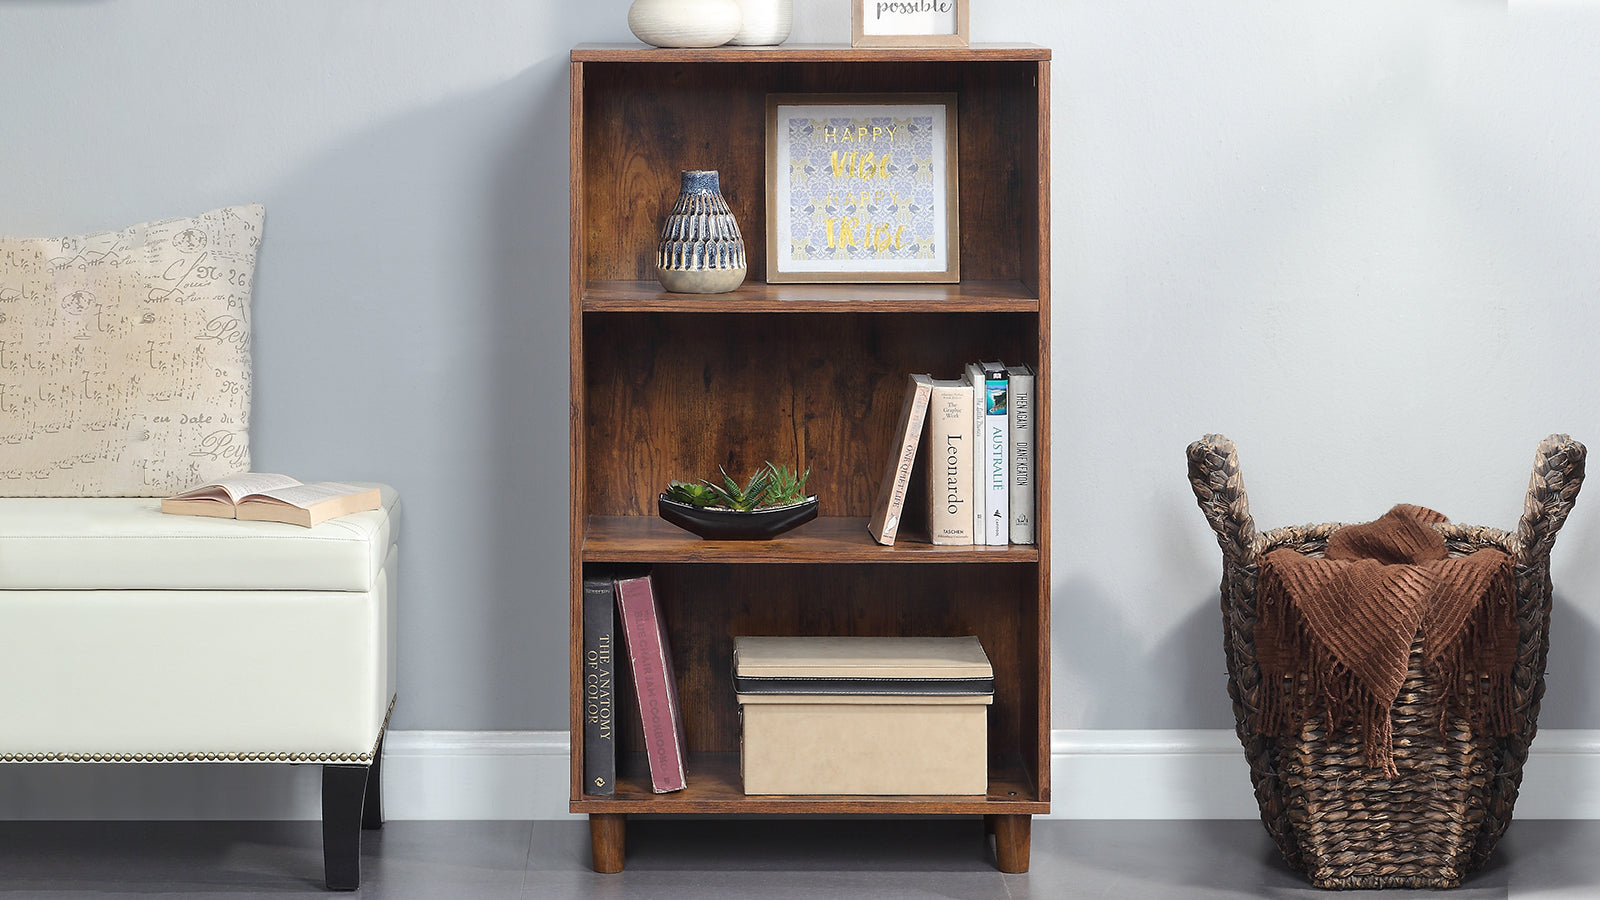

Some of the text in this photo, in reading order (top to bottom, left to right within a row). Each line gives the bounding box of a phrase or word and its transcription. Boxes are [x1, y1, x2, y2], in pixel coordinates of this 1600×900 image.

[877, 0, 953, 20] possible
[824, 127, 897, 143] HAPPY
[831, 150, 894, 181] VIBE
[826, 190, 900, 207] HAPPY
[822, 216, 910, 253] TRIBE
[1016, 392, 1028, 430] THEN AGAIN
[947, 434, 964, 515] Leonardo
[1016, 442, 1028, 486] DIANE KEATON
[587, 650, 599, 724] OF COLOR
[599, 634, 611, 740] THE ANATOMY
